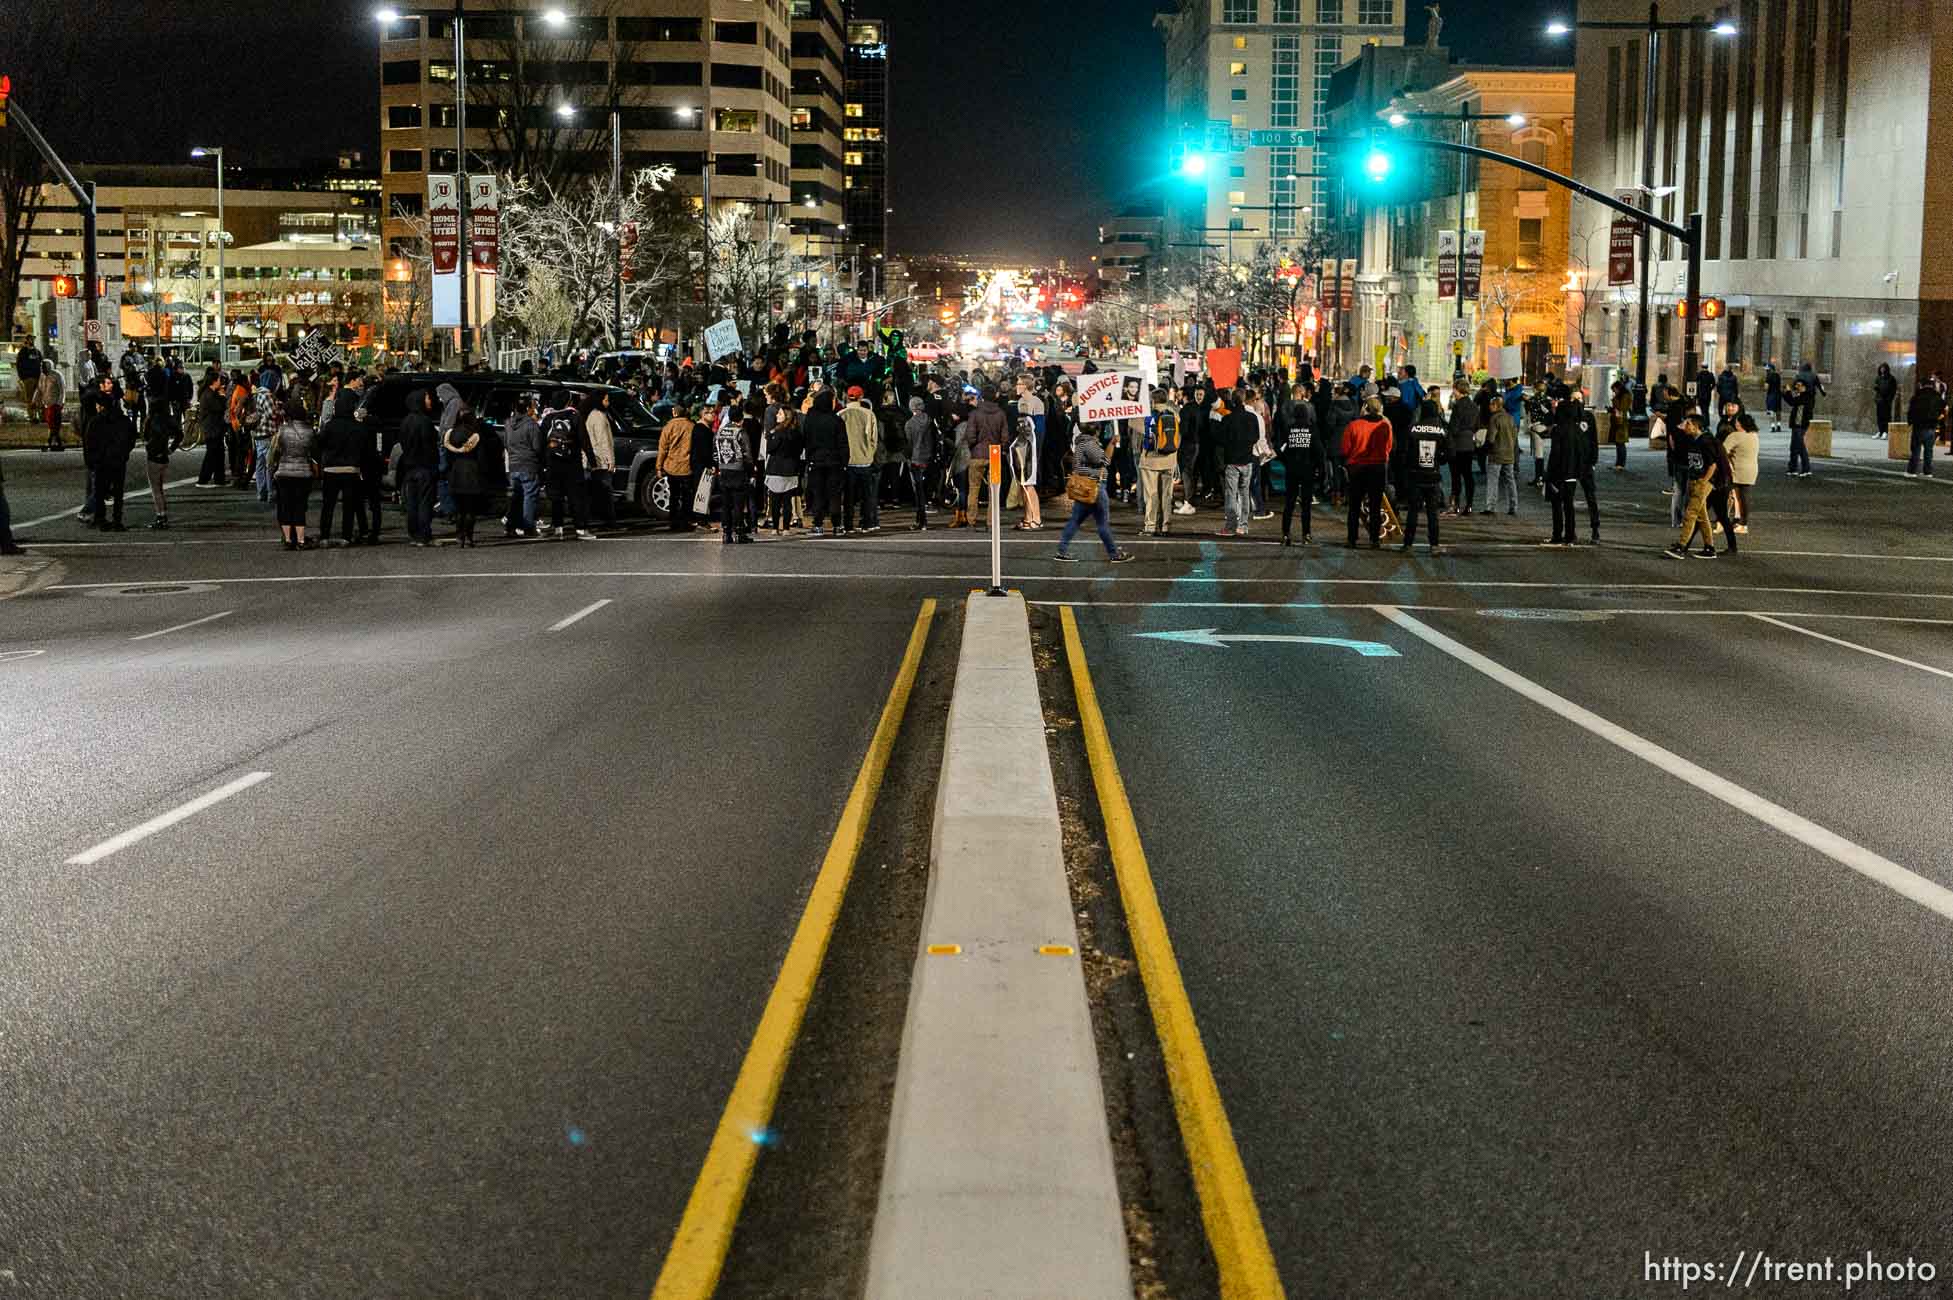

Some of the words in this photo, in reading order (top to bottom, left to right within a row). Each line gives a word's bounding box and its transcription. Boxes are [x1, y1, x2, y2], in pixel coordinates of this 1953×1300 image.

[1262, 133, 1281, 143] 100
[433, 215, 456, 223] HOME
[474, 215, 497, 223] HOME
[434, 227, 457, 236] UTES
[474, 227, 497, 236] UTES
[1453, 329, 1467, 338] 30
[1080, 374, 1119, 406] JUSTICE
[1105, 391, 1113, 402] 4
[1088, 404, 1143, 420] DARRIEN
